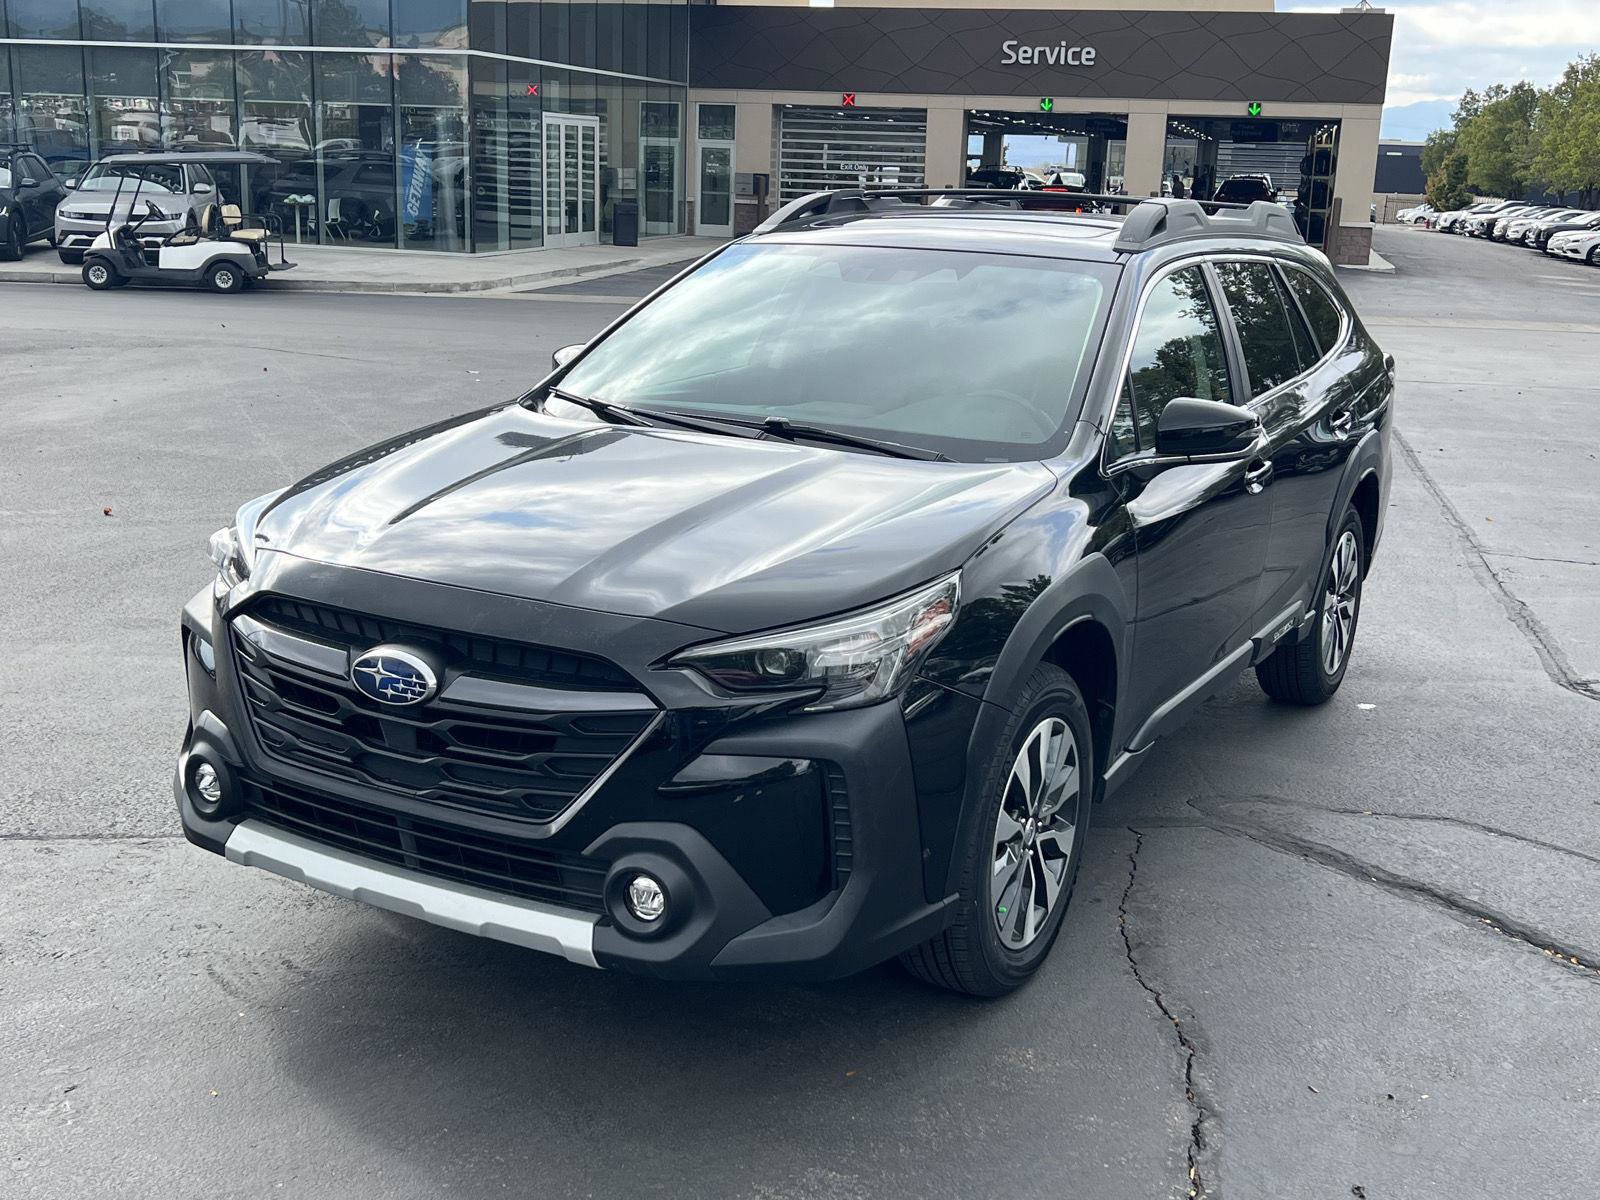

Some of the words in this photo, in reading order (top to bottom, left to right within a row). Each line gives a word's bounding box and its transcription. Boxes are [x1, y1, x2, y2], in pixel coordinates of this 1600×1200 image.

[1001, 40, 1096, 66] Service
[840, 162, 853, 171] Exit
[854, 161, 869, 173] Only
